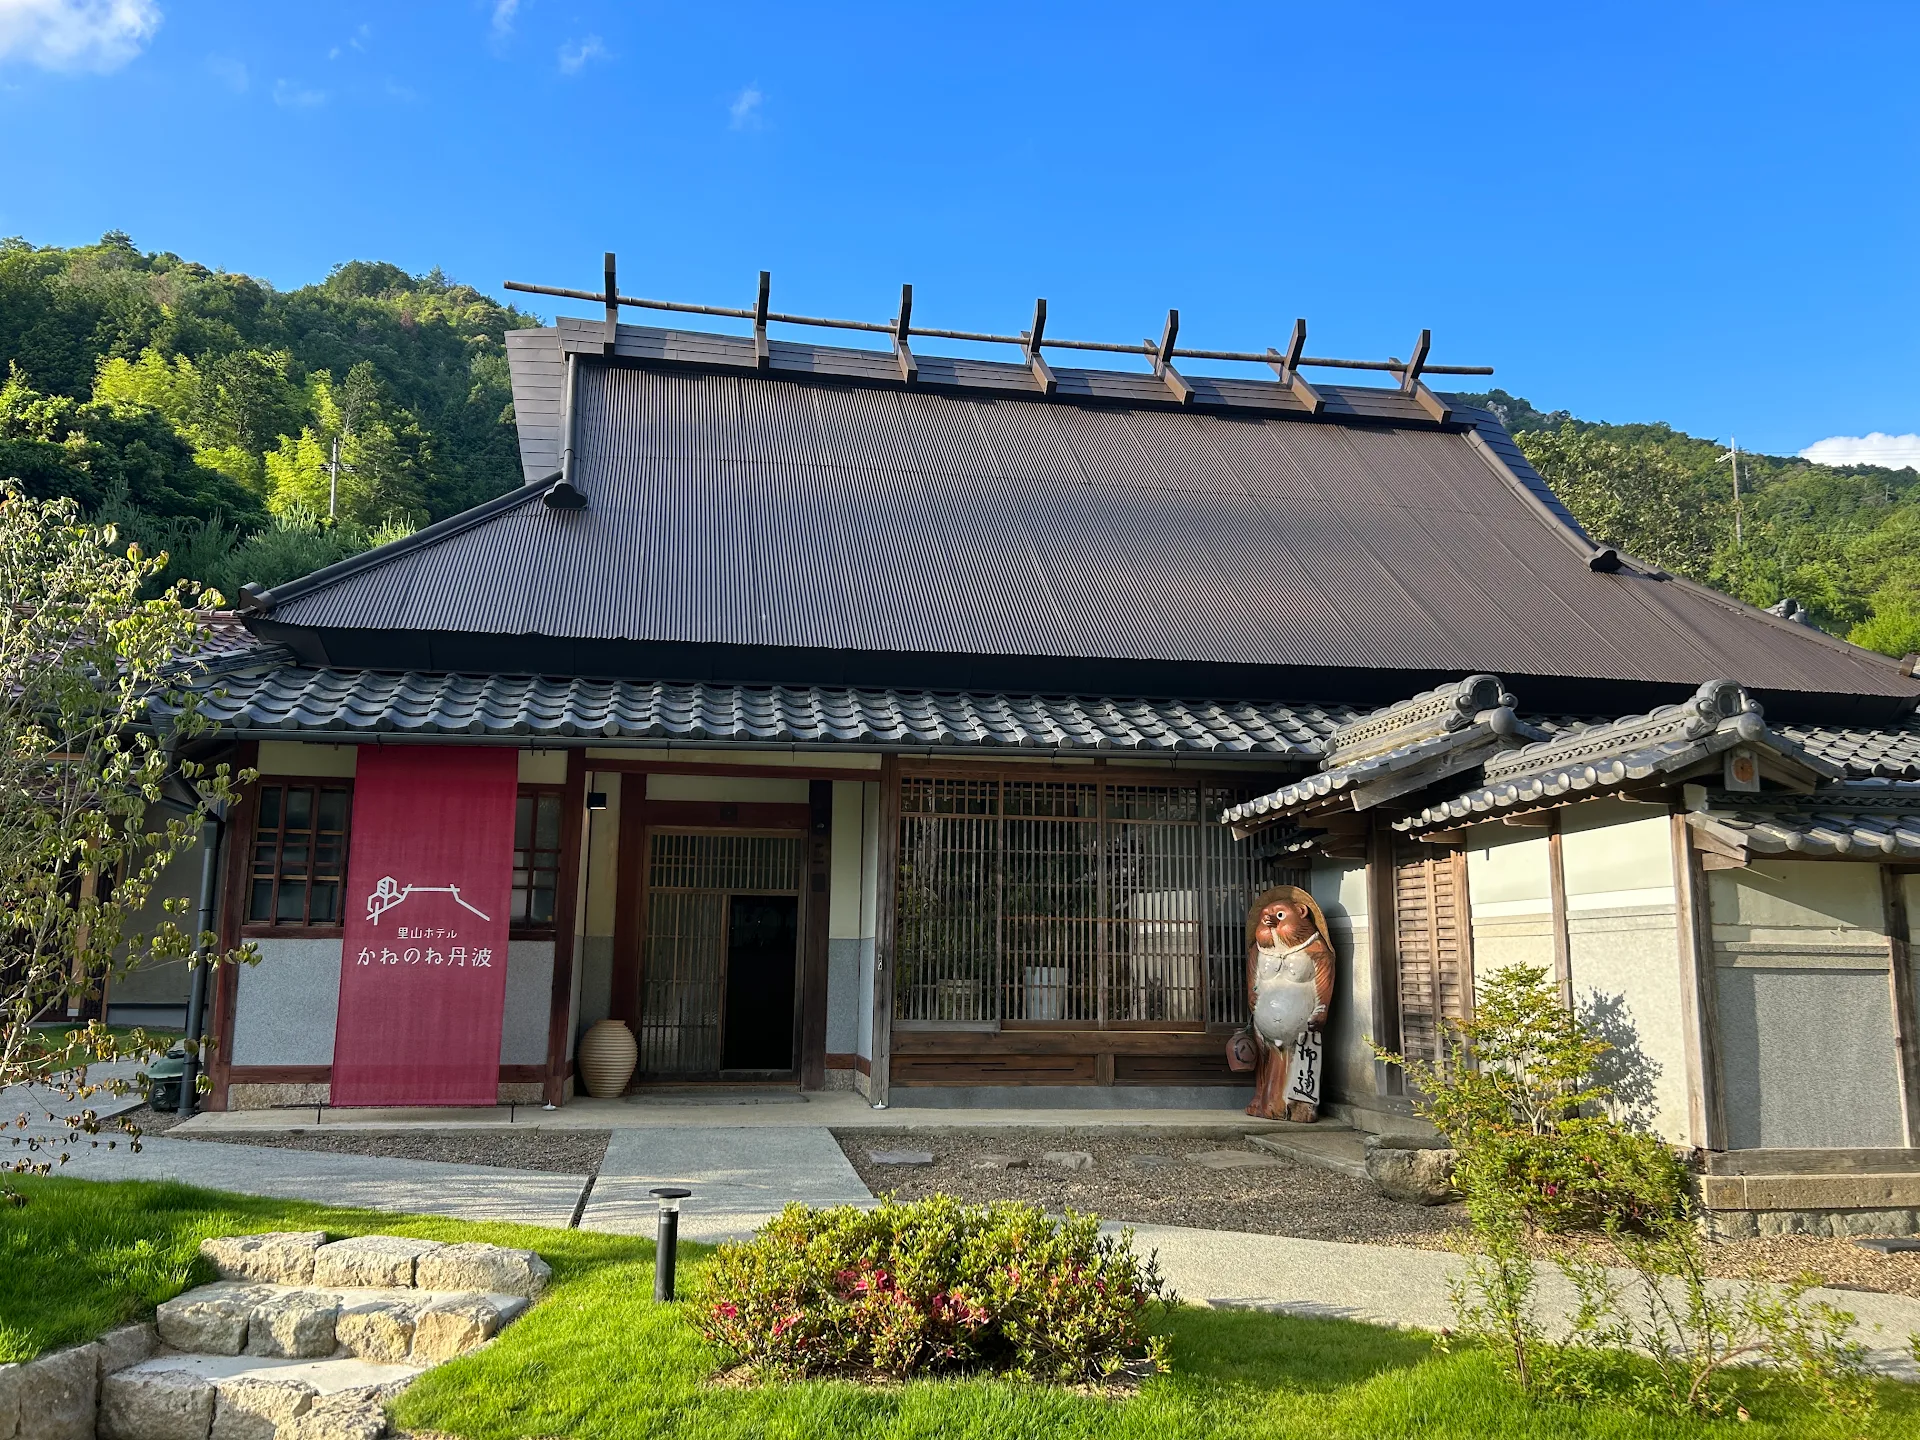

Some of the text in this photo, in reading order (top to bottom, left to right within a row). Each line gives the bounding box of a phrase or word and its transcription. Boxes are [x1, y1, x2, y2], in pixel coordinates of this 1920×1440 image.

[397, 927, 458, 939] 里山ホテル
[357, 946, 492, 968] かねのね丹波
